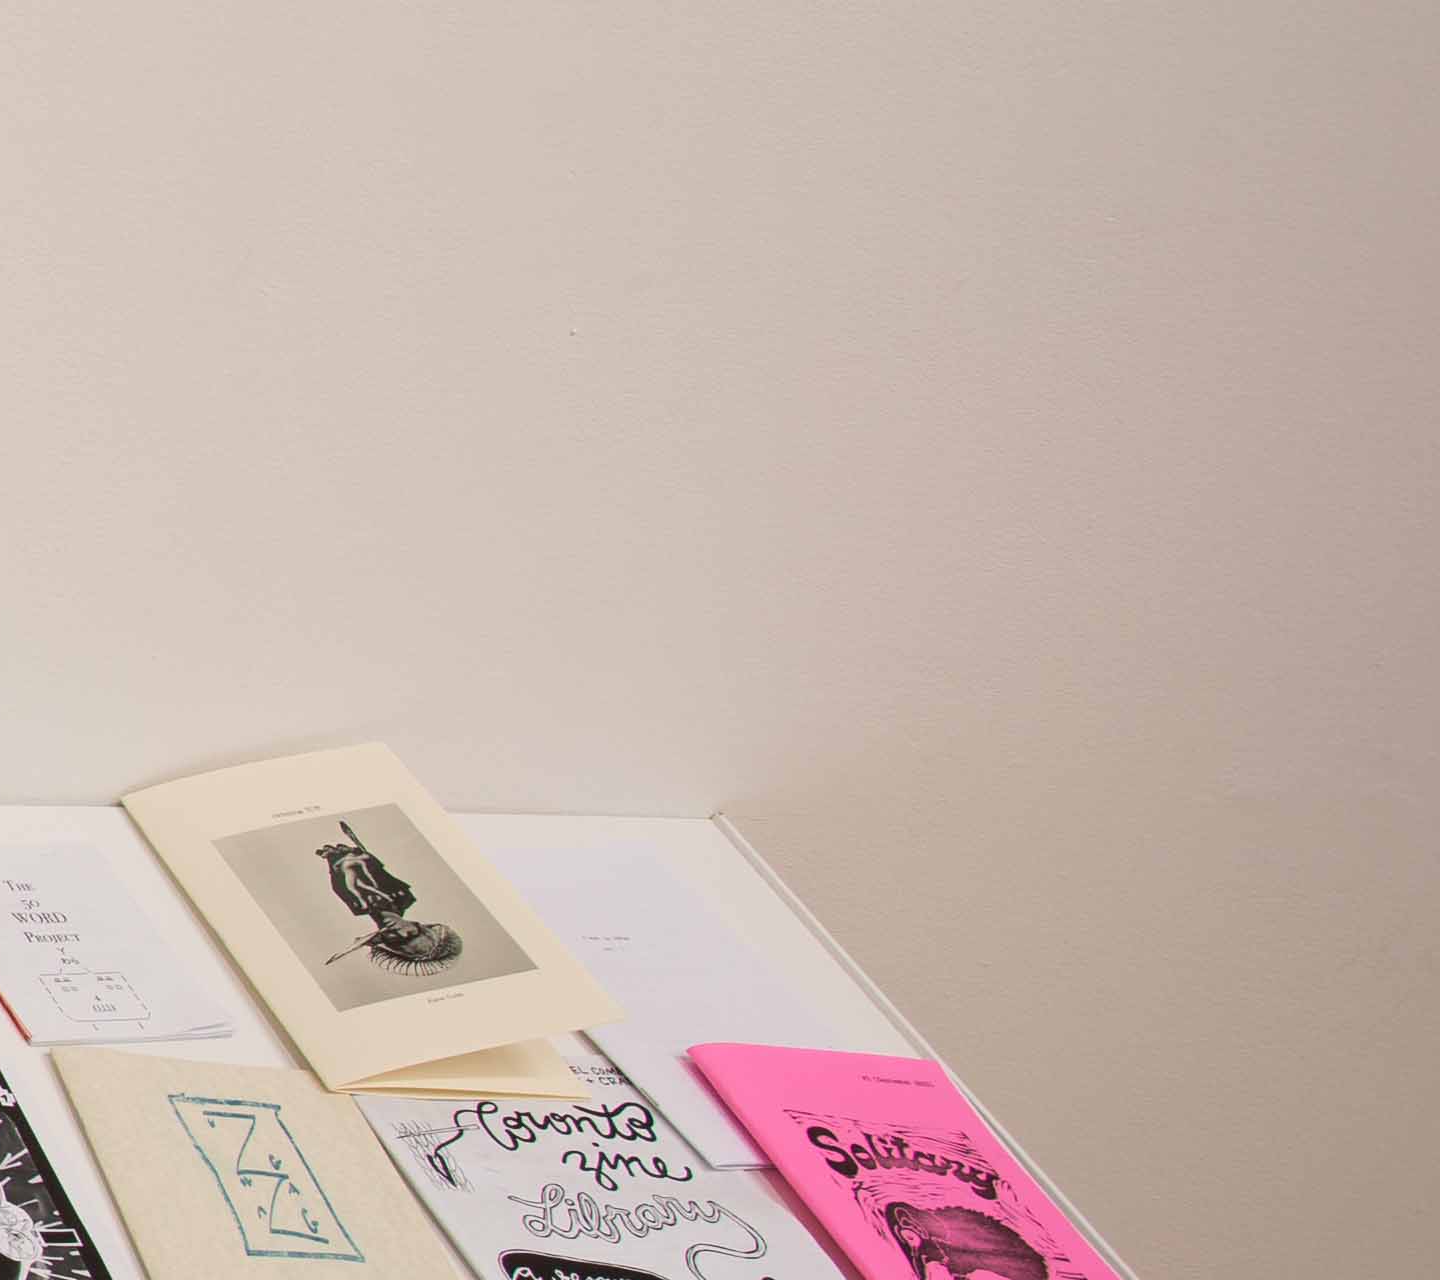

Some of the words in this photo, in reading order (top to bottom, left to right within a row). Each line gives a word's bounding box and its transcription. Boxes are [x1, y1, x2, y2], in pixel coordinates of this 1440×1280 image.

[11, 911, 69, 924] WORD
[477, 1101, 657, 1151] Toronto
[562, 1143, 693, 1192] zine
[806, 1125, 1000, 1201] Solitary
[507, 1183, 723, 1244] Library
